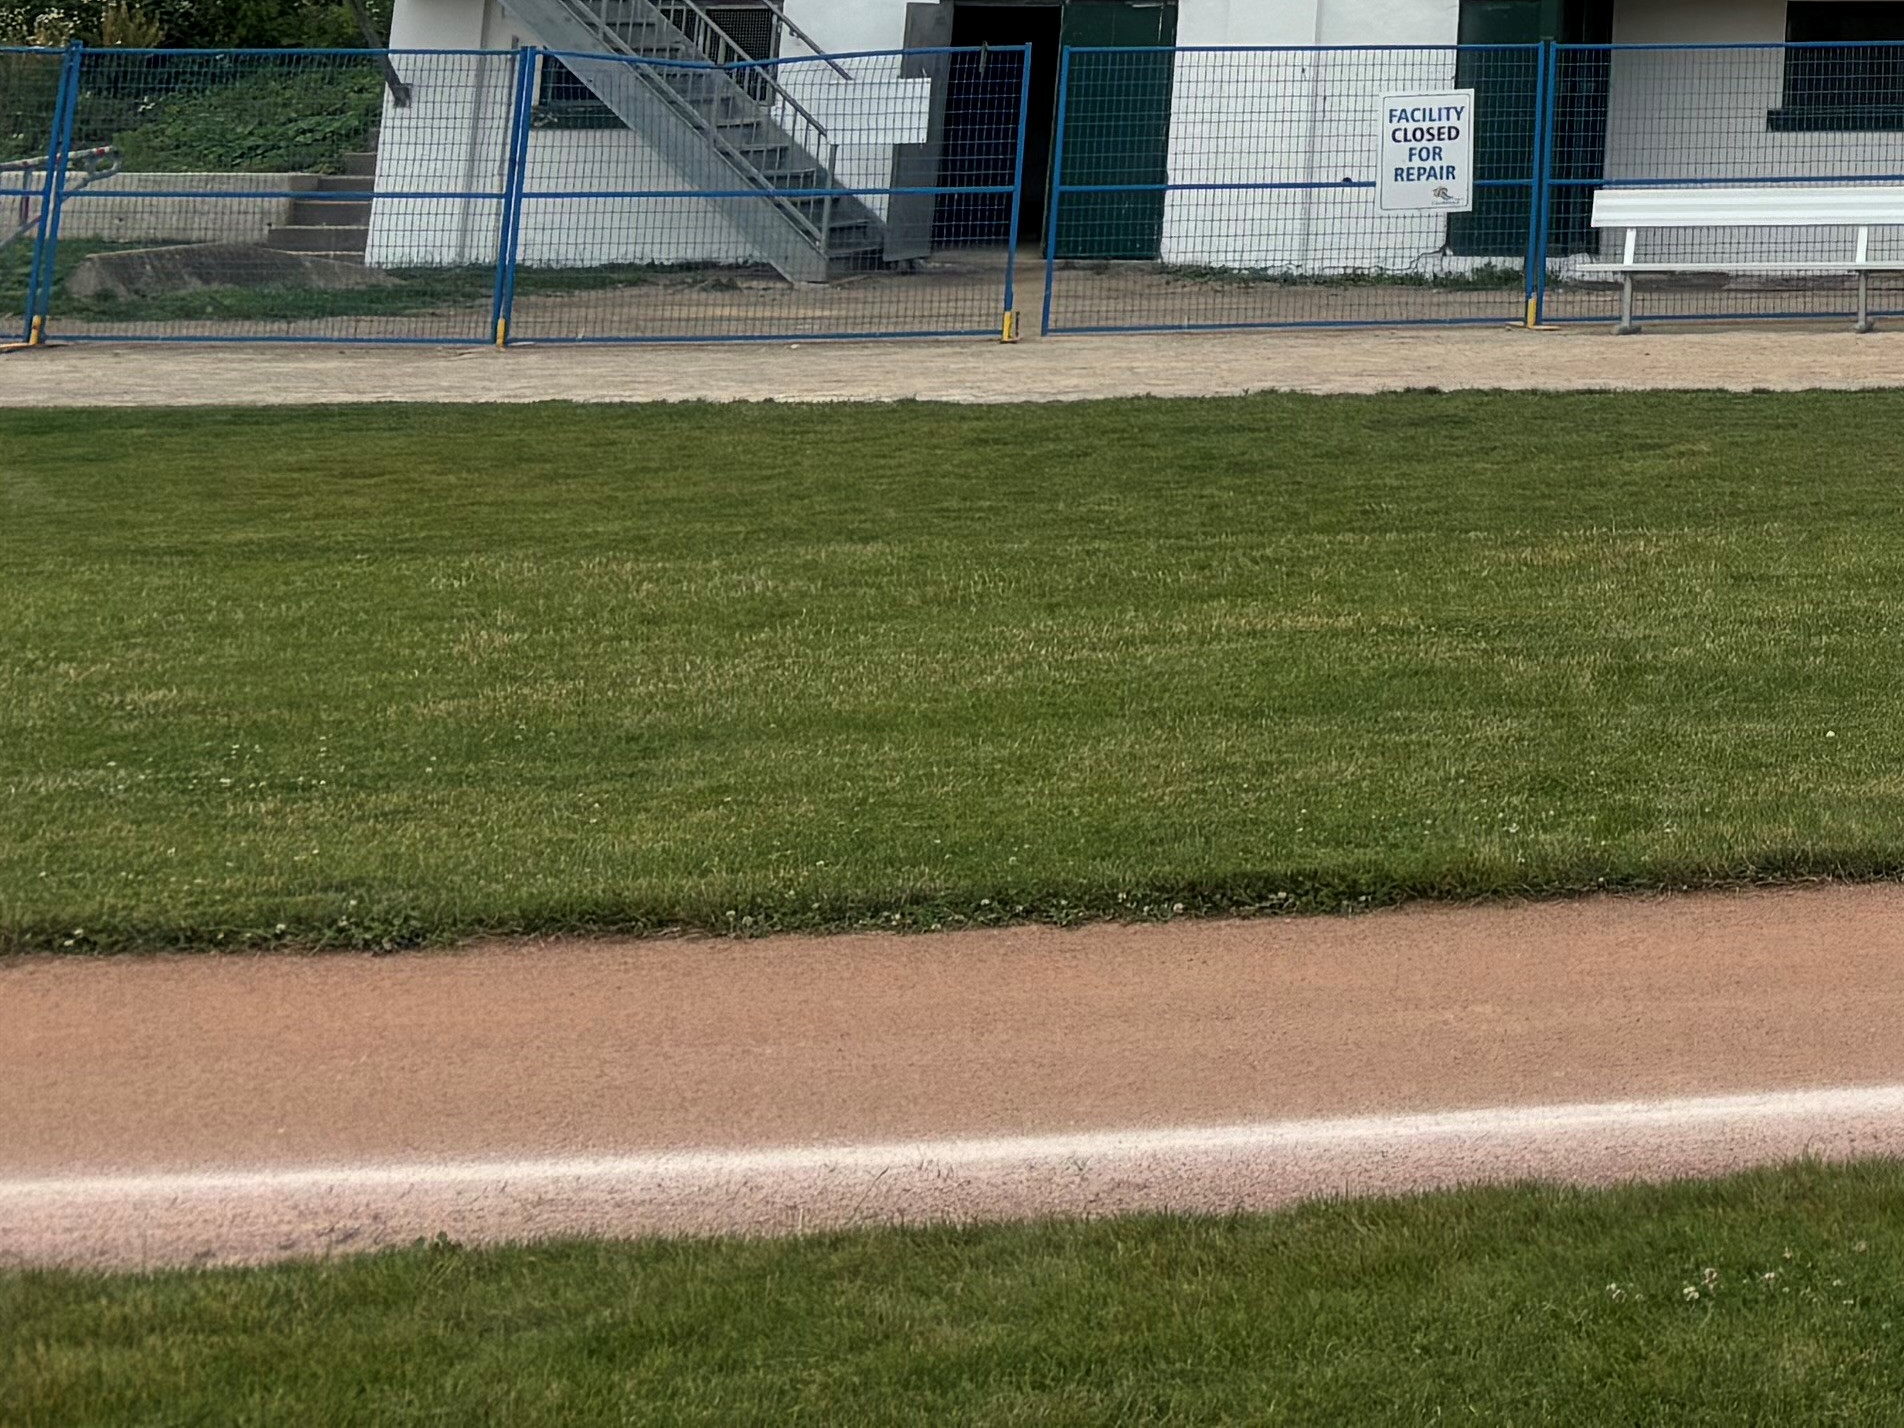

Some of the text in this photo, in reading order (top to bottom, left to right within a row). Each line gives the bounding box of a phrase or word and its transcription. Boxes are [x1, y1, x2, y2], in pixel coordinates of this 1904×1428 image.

[1389, 106, 1464, 123] FACILITY
[1391, 126, 1460, 143] CLOSED
[1408, 146, 1443, 162] FOR
[1394, 165, 1456, 182] REPAIR
